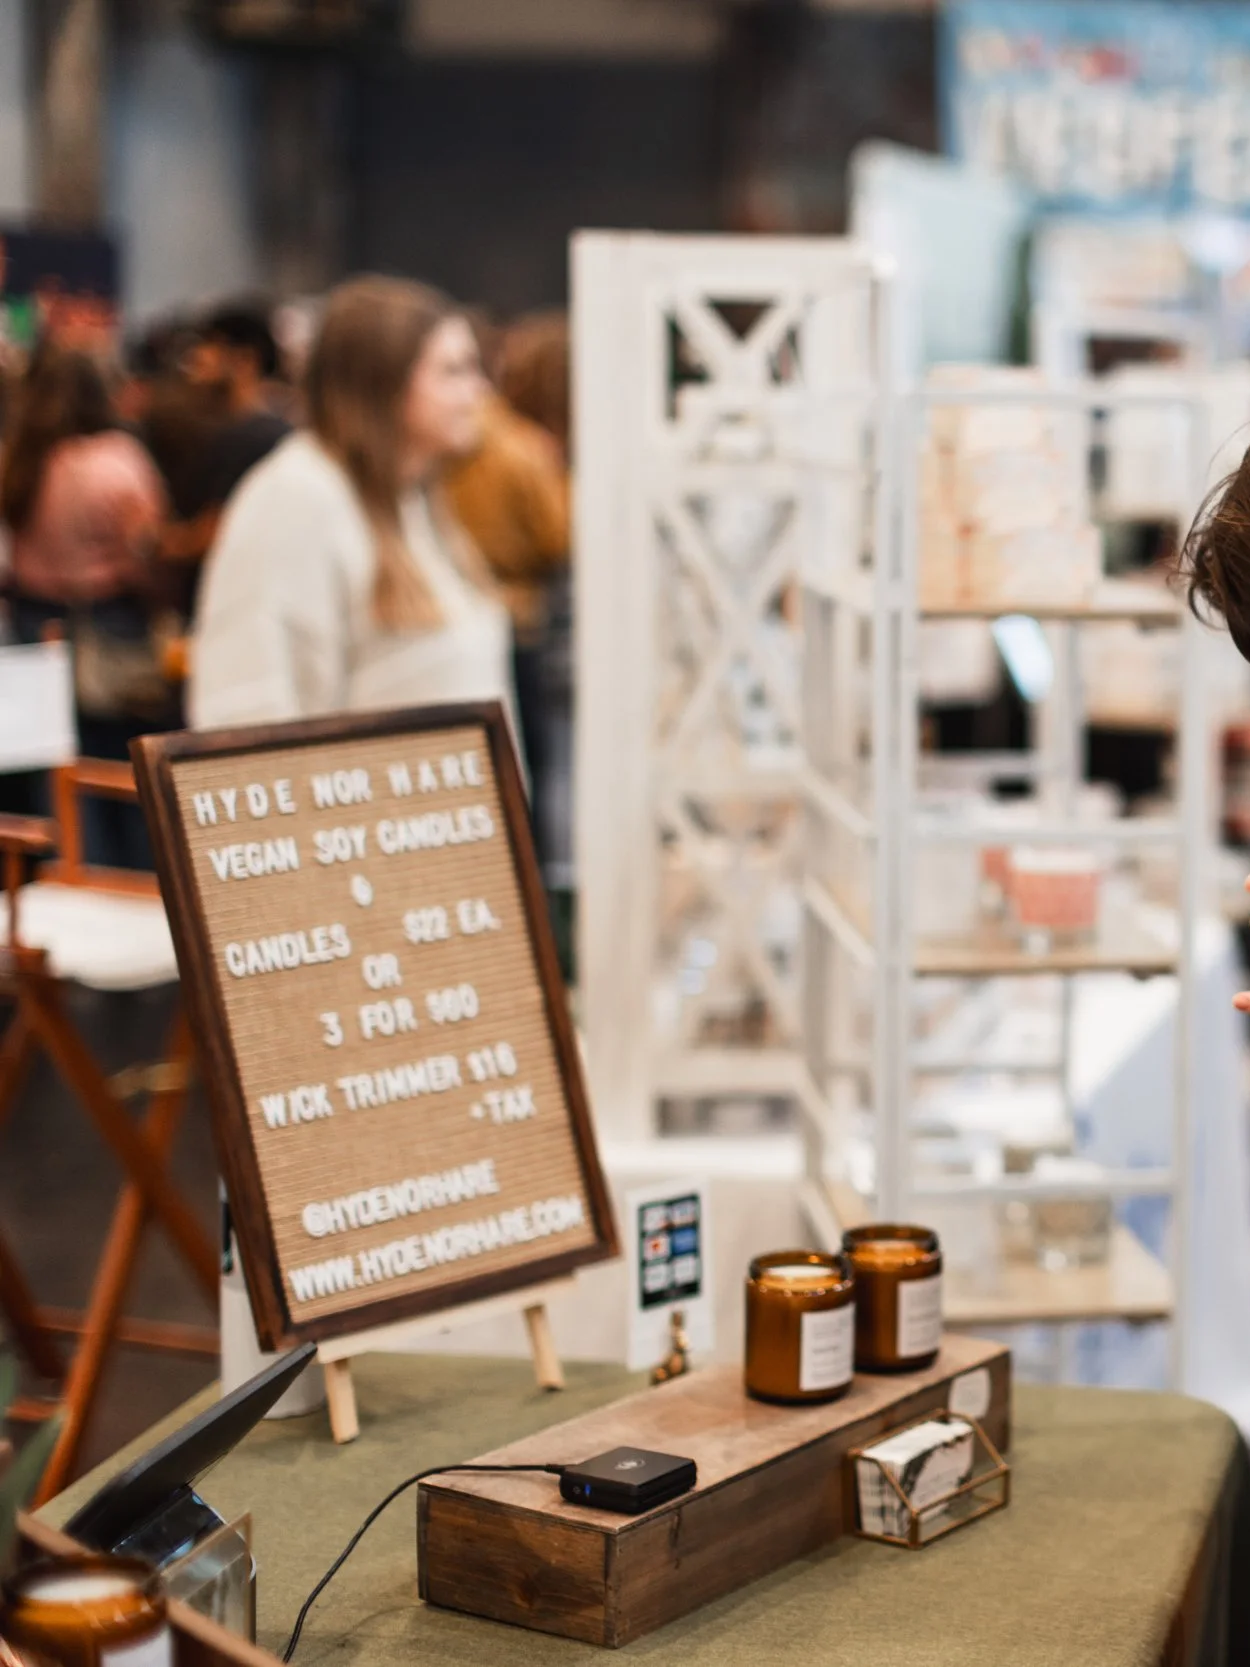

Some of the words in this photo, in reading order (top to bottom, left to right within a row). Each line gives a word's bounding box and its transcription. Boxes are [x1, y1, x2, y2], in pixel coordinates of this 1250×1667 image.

[192, 778, 296, 826] HYDE
[310, 768, 372, 809] NOR
[208, 836, 299, 882] VEGAN
[312, 824, 367, 865] SOY
[376, 804, 494, 855] CANDLES
[225, 922, 352, 978] CANDLES
[361, 952, 402, 990] OR
[319, 1011, 344, 1047] 3
[359, 996, 418, 1040] FOR
[260, 1082, 334, 1129] WICK
[337, 1053, 462, 1110] TRIMMER
